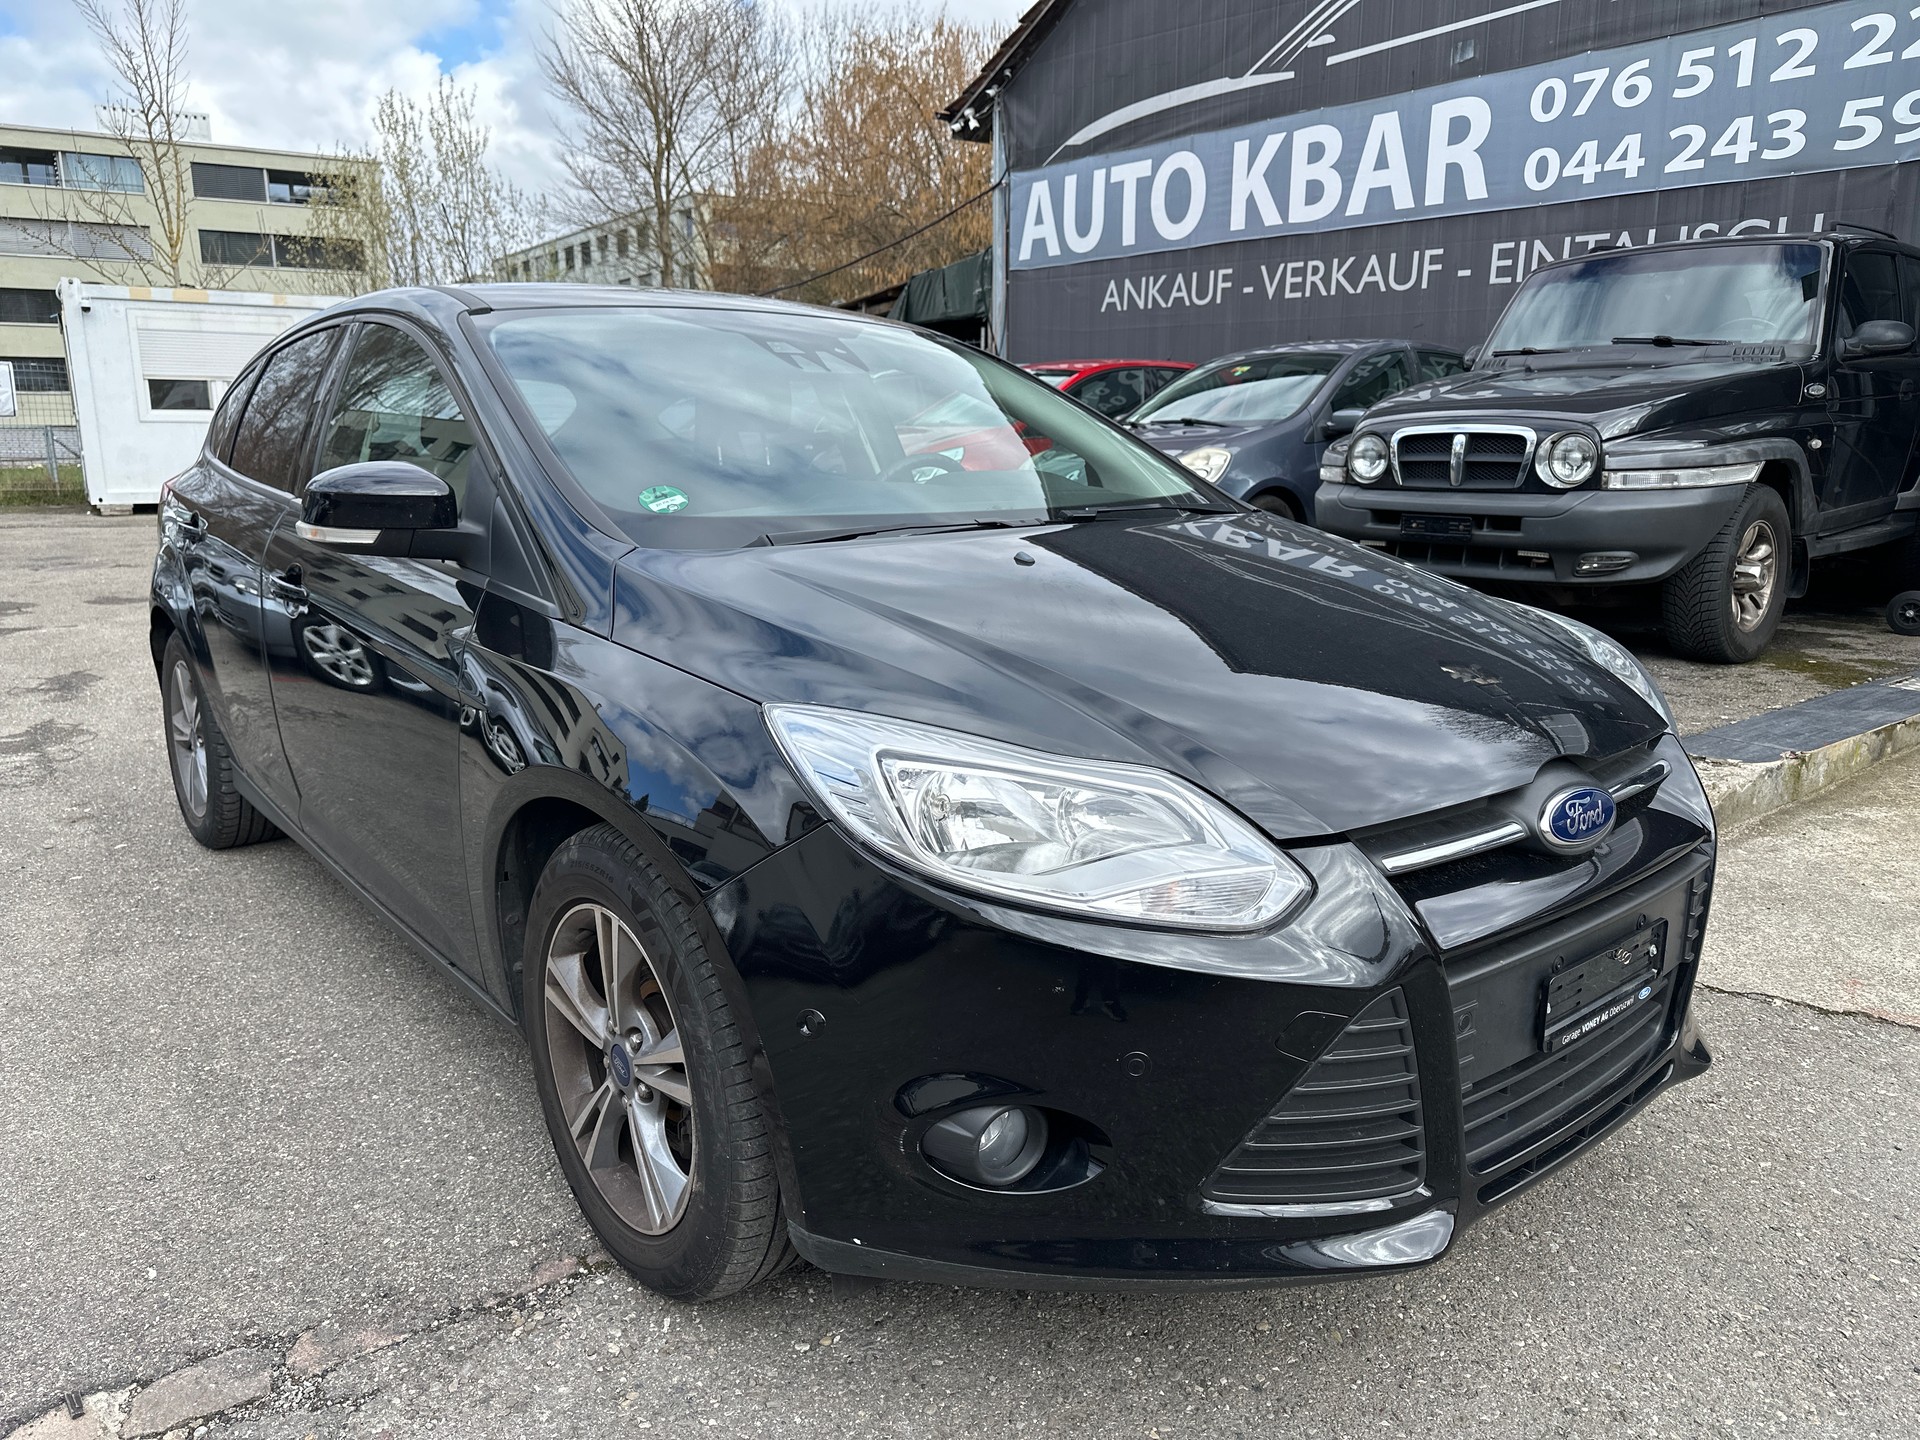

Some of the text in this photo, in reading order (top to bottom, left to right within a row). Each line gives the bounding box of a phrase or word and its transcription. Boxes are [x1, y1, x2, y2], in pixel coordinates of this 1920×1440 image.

[1530, 59, 1653, 123] 076
[1672, 27, 1819, 99] 512
[1018, 96, 1492, 262] AUTO KBAR
[1523, 133, 1645, 191] 044
[1664, 109, 1807, 174] 243
[1101, 268, 1233, 313] ANKAUF
[1260, 248, 1444, 301] VERKAUF
[1565, 796, 1605, 835] Ford
[1562, 1028, 1581, 1045] Garage
[1601, 1011, 1609, 1023] AG
